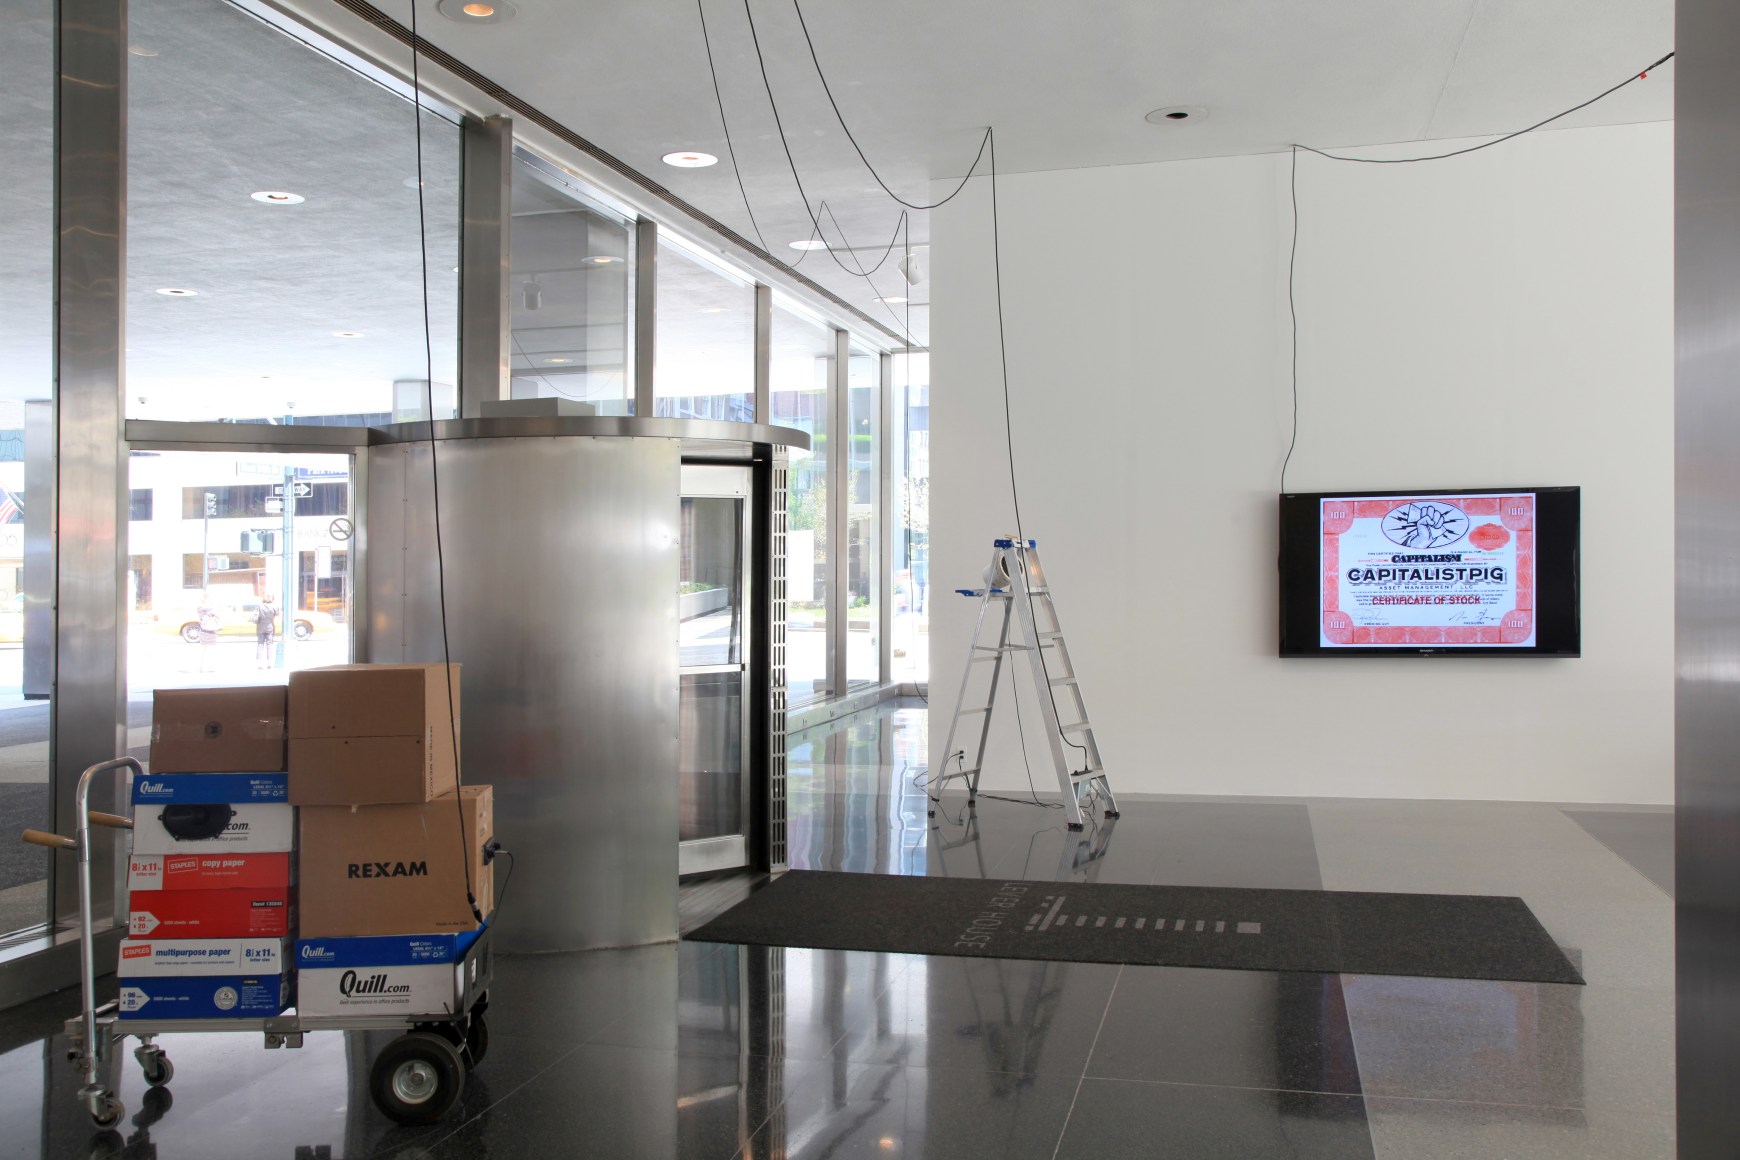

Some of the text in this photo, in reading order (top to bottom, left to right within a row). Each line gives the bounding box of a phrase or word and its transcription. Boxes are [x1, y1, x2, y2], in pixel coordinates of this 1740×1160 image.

[1330, 511, 1346, 519] 100
[1508, 507, 1524, 516] 100
[1391, 554, 1462, 563] CAPITALISM
[1347, 567, 1505, 582] CAPITALISTPIG
[1372, 596, 1432, 606] CERTIFICATE
[1434, 596, 1445, 605] OF
[1449, 595, 1481, 605] STOCK
[1330, 621, 1346, 629] 100
[1508, 620, 1524, 628] 100
[140, 781, 174, 795] Quill.com
[149, 862, 157, 871] 11
[170, 859, 246, 870] STAPLES copy paper
[348, 861, 428, 878] REXAM
[954, 882, 1029, 948] LEVER HOUSE
[124, 947, 151, 956] STAPLES
[155, 948, 207, 958] multipurpose
[208, 948, 232, 958] paper
[263, 948, 270, 957] 11
[302, 945, 335, 959] Quill.com
[340, 969, 410, 998] Quill.com
